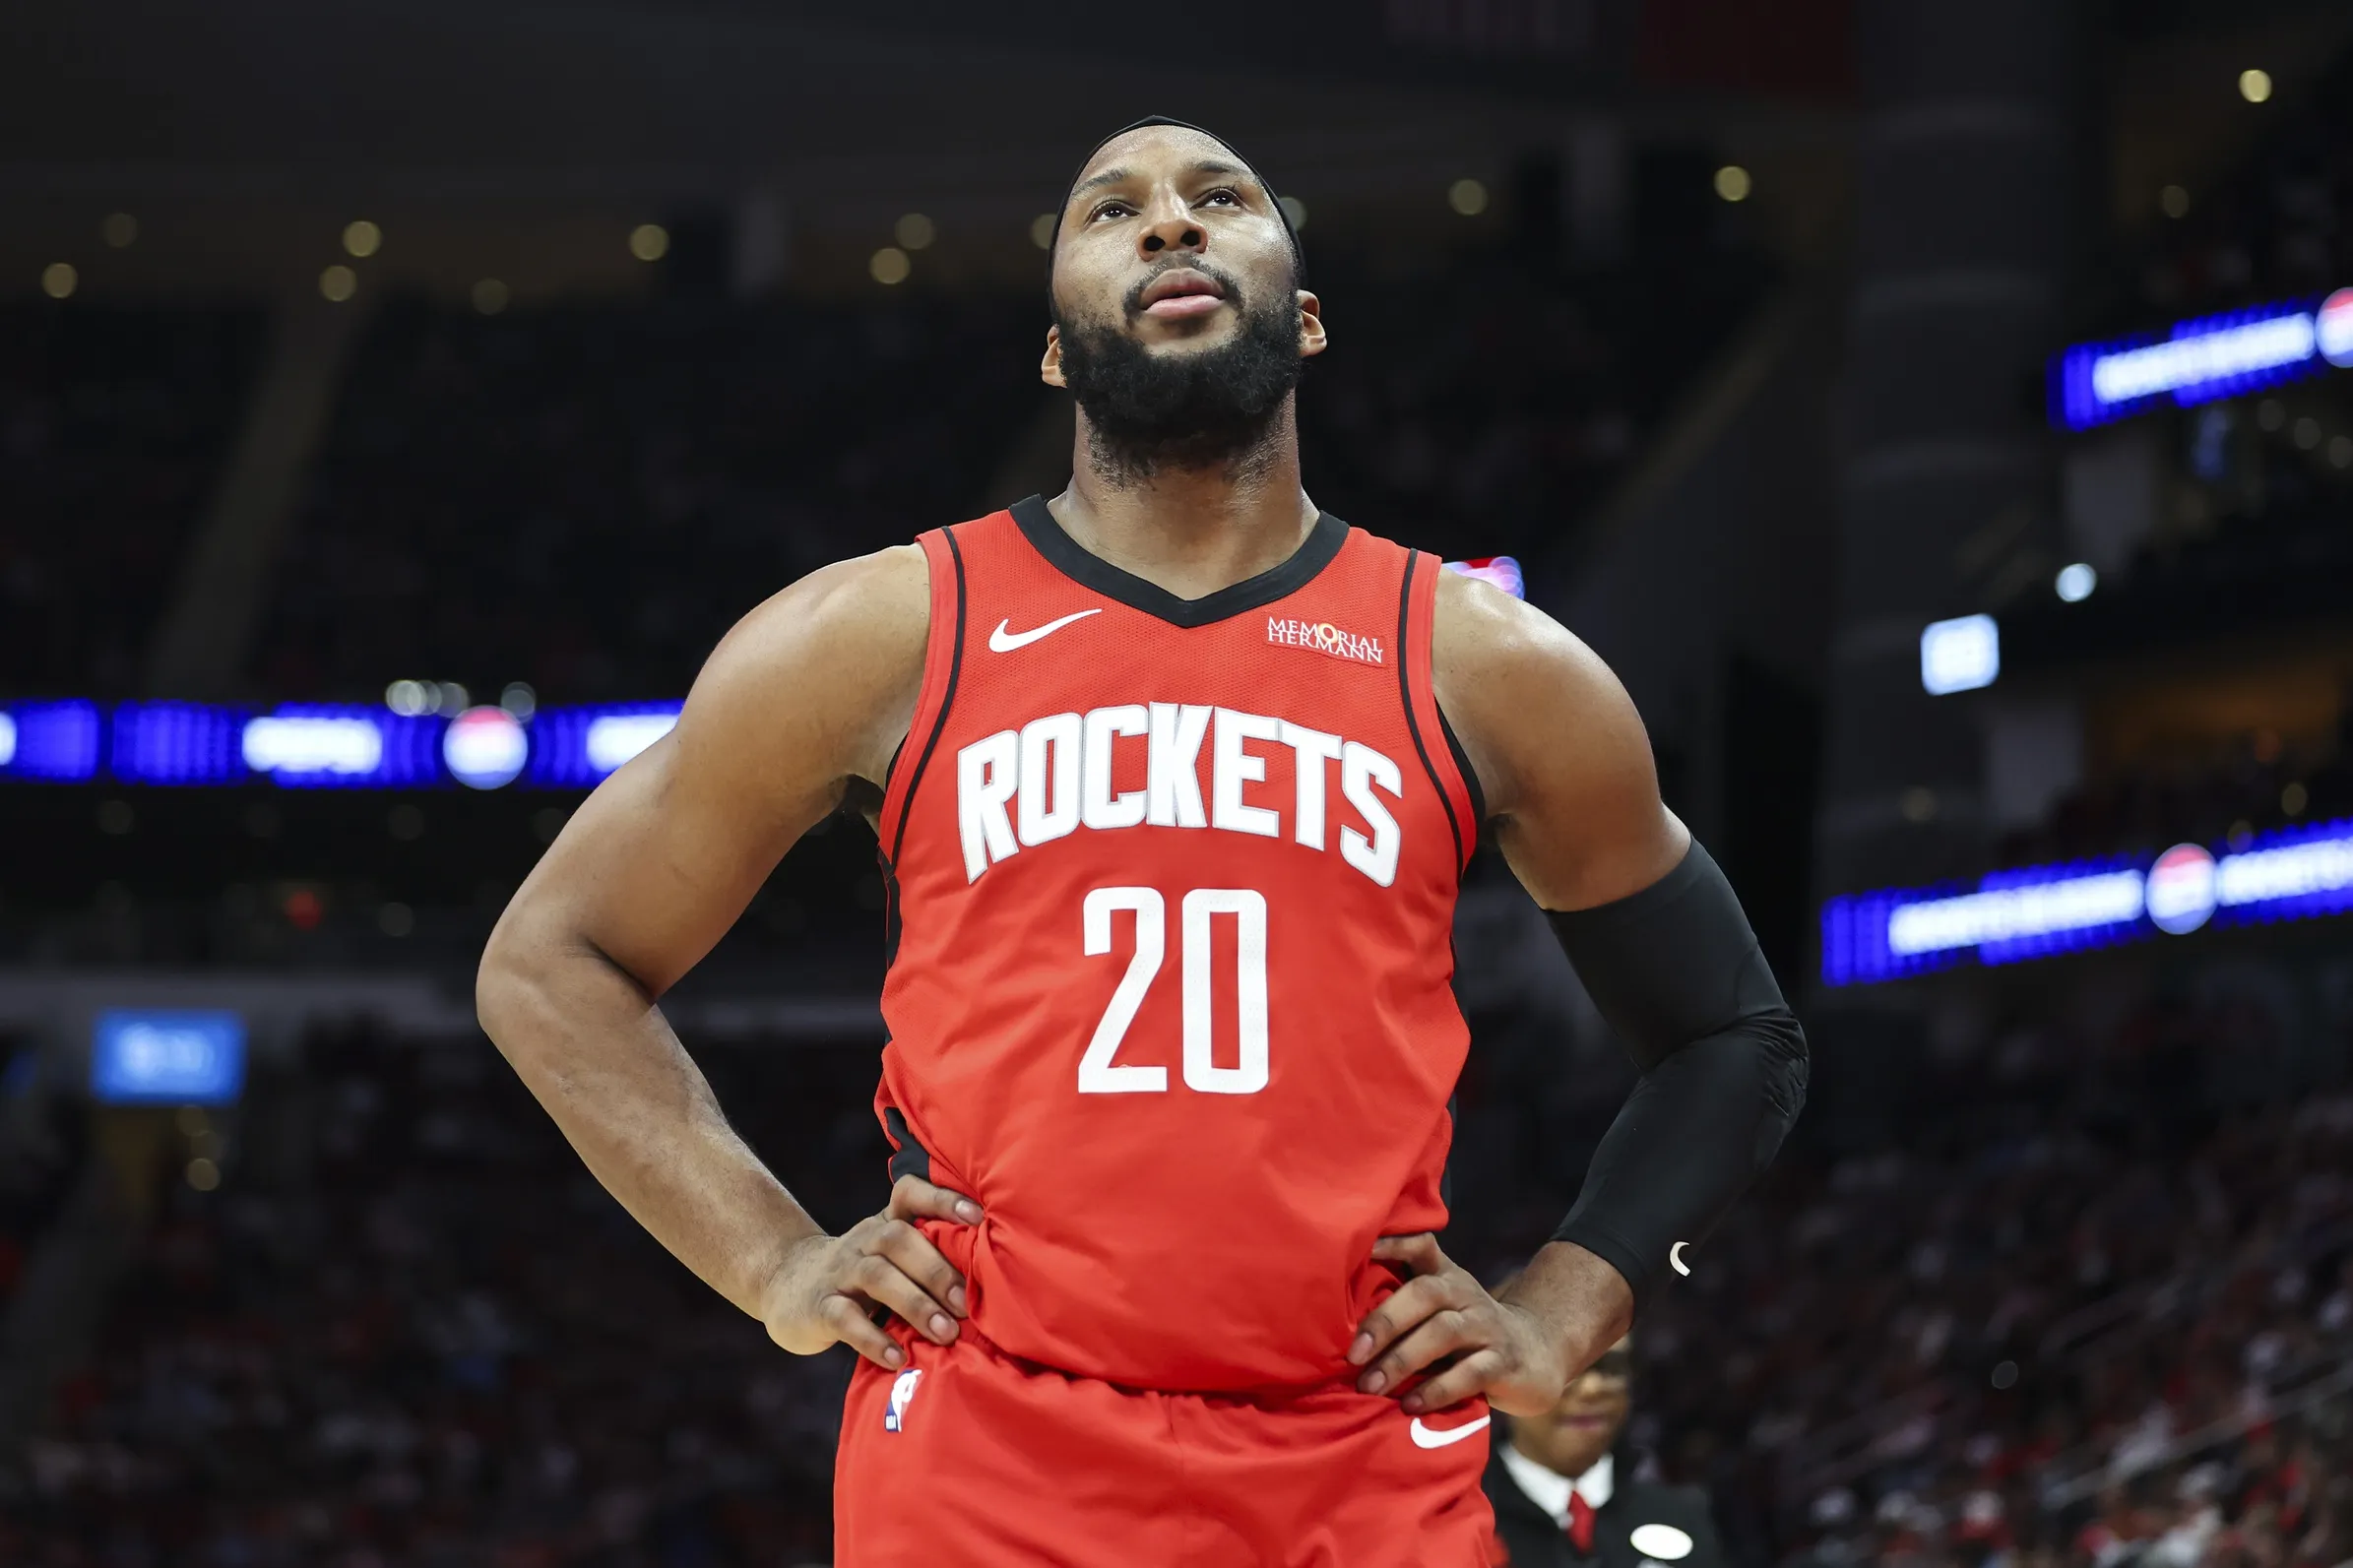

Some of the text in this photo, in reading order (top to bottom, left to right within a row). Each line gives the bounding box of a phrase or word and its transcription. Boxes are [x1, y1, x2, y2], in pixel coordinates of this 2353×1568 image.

[1267, 616, 1383, 652] MEMORIAL
[1268, 627, 1382, 663] HERMANN
[957, 701, 1402, 888] ROCKETS
[1078, 886, 1269, 1094] 20
